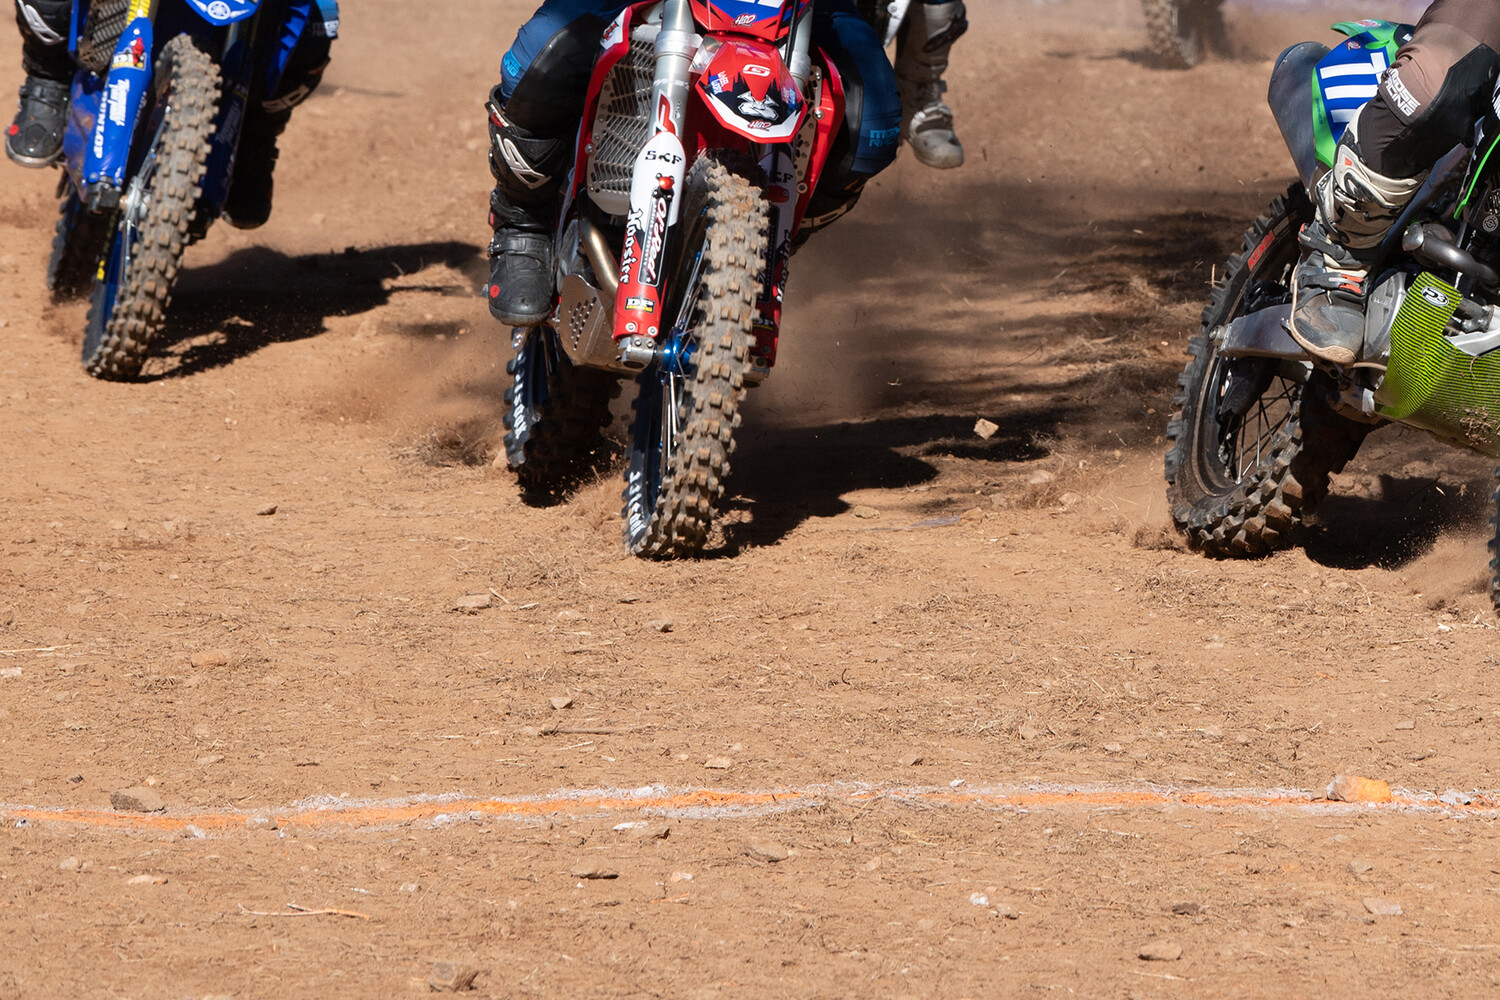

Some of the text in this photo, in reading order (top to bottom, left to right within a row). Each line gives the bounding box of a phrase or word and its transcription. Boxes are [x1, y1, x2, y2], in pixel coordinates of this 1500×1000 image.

[1384, 79, 1418, 117] RACING
[1387, 67, 1422, 110] MOOSE
[645, 149, 683, 165] SKF
[620, 207, 644, 285] Hoosier
[1248, 230, 1276, 271] KENDA
